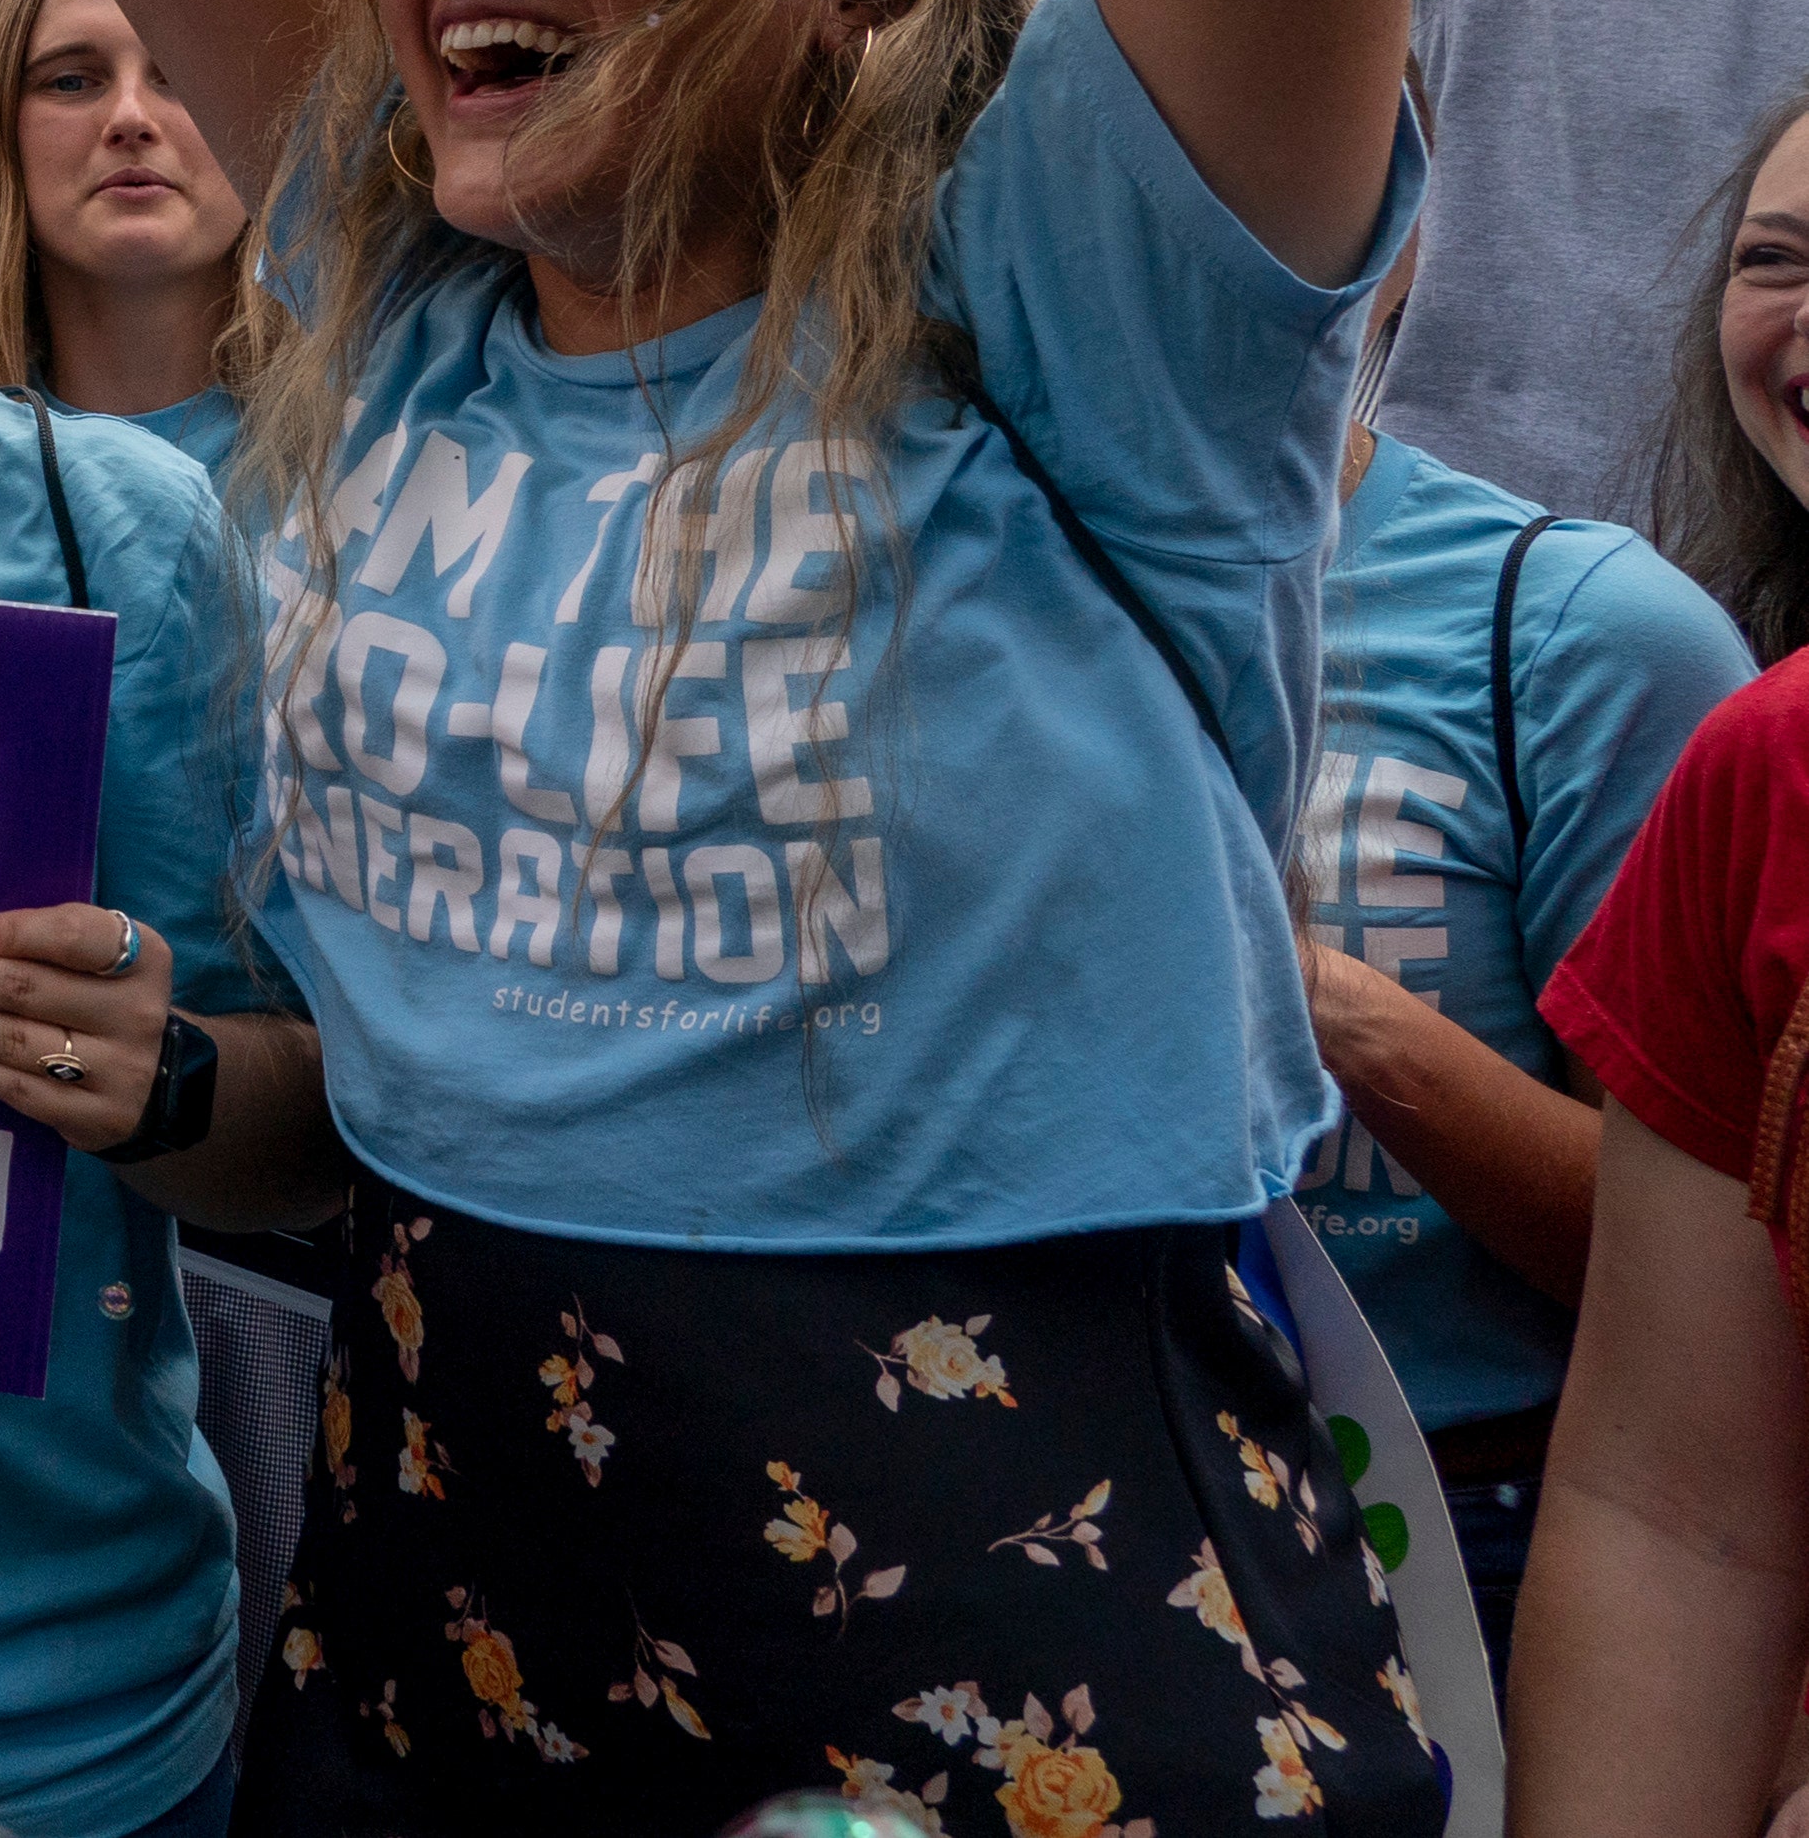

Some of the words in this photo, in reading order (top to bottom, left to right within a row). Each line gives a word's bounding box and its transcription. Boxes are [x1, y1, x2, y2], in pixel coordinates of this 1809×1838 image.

[554, 437, 873, 628] THE
[264, 586, 874, 833] RO-LIFE
[491, 985, 882, 1036] studentsforlife.org
